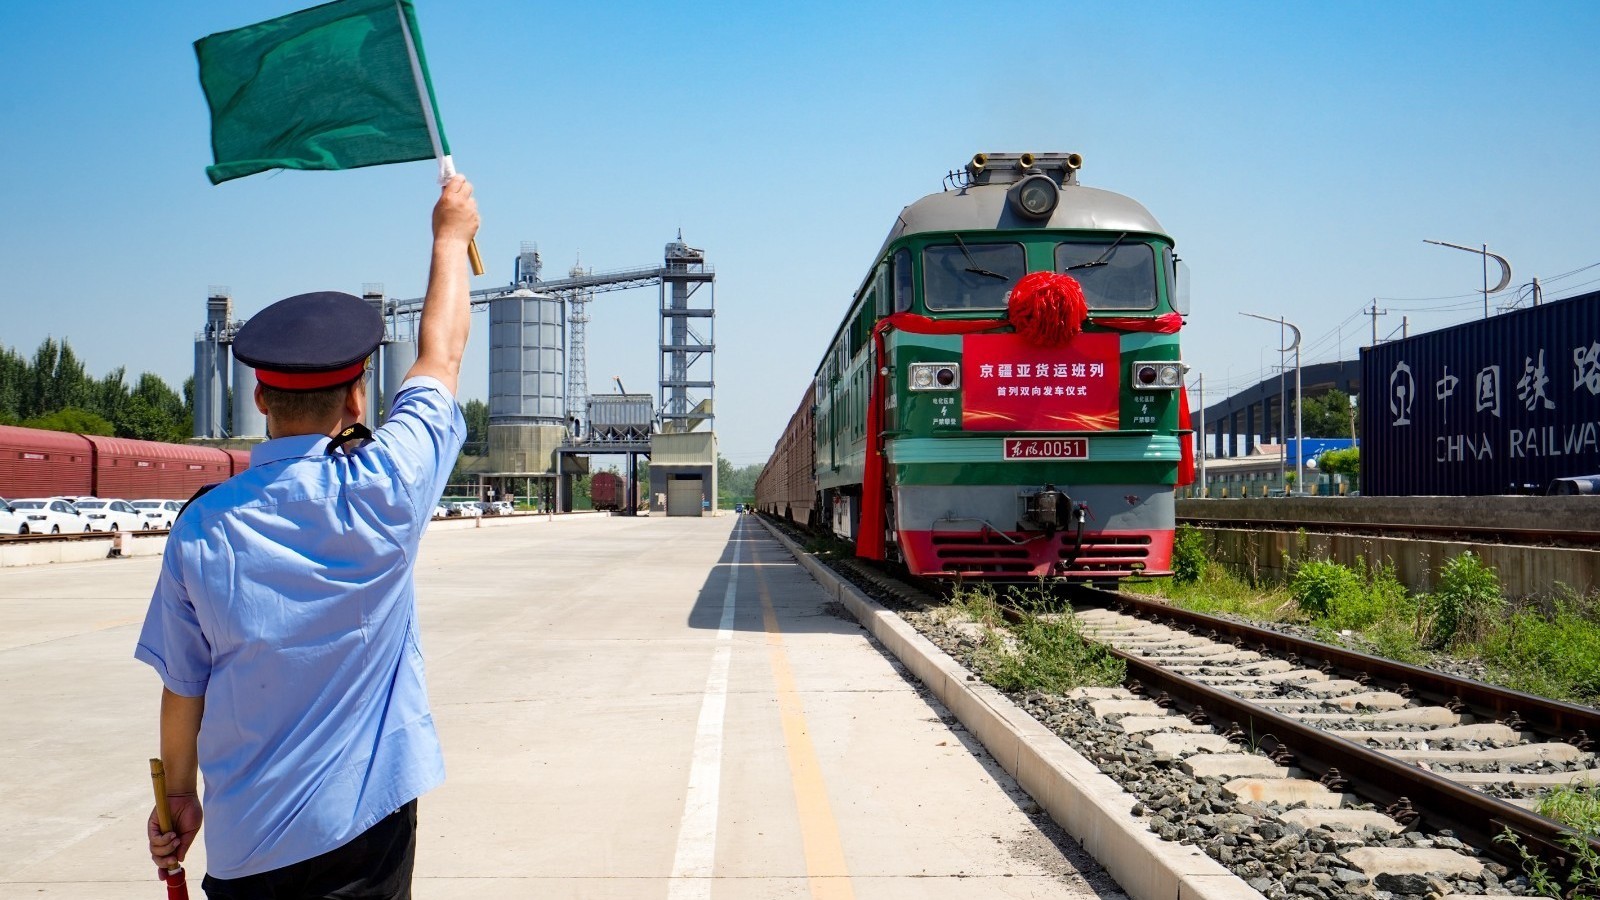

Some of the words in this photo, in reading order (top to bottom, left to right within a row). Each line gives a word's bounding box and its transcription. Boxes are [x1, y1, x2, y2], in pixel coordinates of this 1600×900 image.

[980, 363, 1104, 378] 京疆亚货运班列
[1436, 339, 1600, 425] 中国铁路
[997, 386, 1087, 396] 首列双向发车仪式
[1436, 432, 1493, 462] CHINA
[1509, 421, 1600, 458] RAILWA
